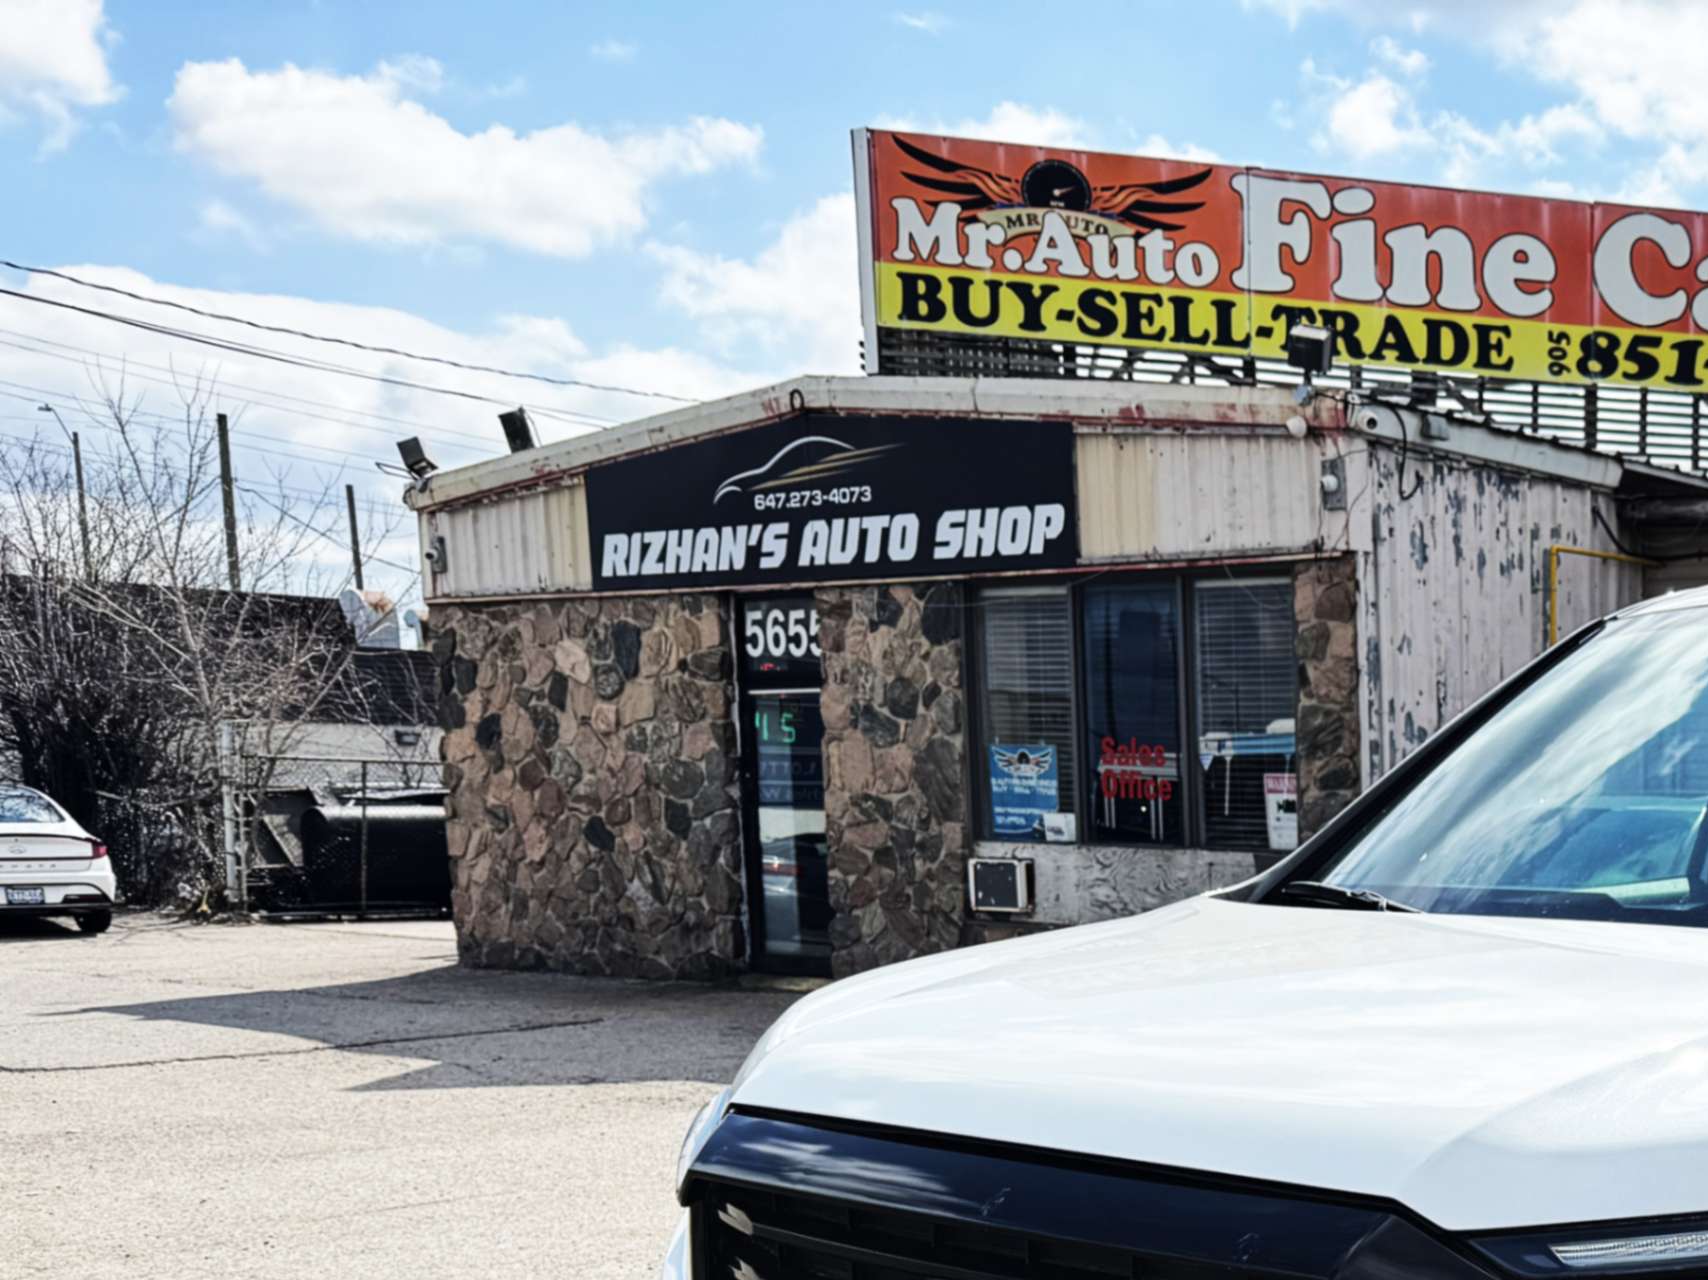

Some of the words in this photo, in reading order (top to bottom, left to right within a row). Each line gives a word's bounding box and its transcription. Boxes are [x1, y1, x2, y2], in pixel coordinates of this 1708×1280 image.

[1005, 212, 1039, 229] MR
[891, 197, 1220, 289] Mr.Auto
[1229, 171, 1557, 319] Fine
[896, 270, 1514, 372] BUY-SELL-TRADE
[1547, 330, 1572, 377] 905
[753, 485, 872, 511] 647.273-4073
[601, 522, 790, 577] RIZHAN'S
[798, 513, 919, 567] AUTO
[932, 502, 1065, 560] SHOP
[1101, 736, 1168, 768] Sales
[1101, 768, 1173, 801] Office
